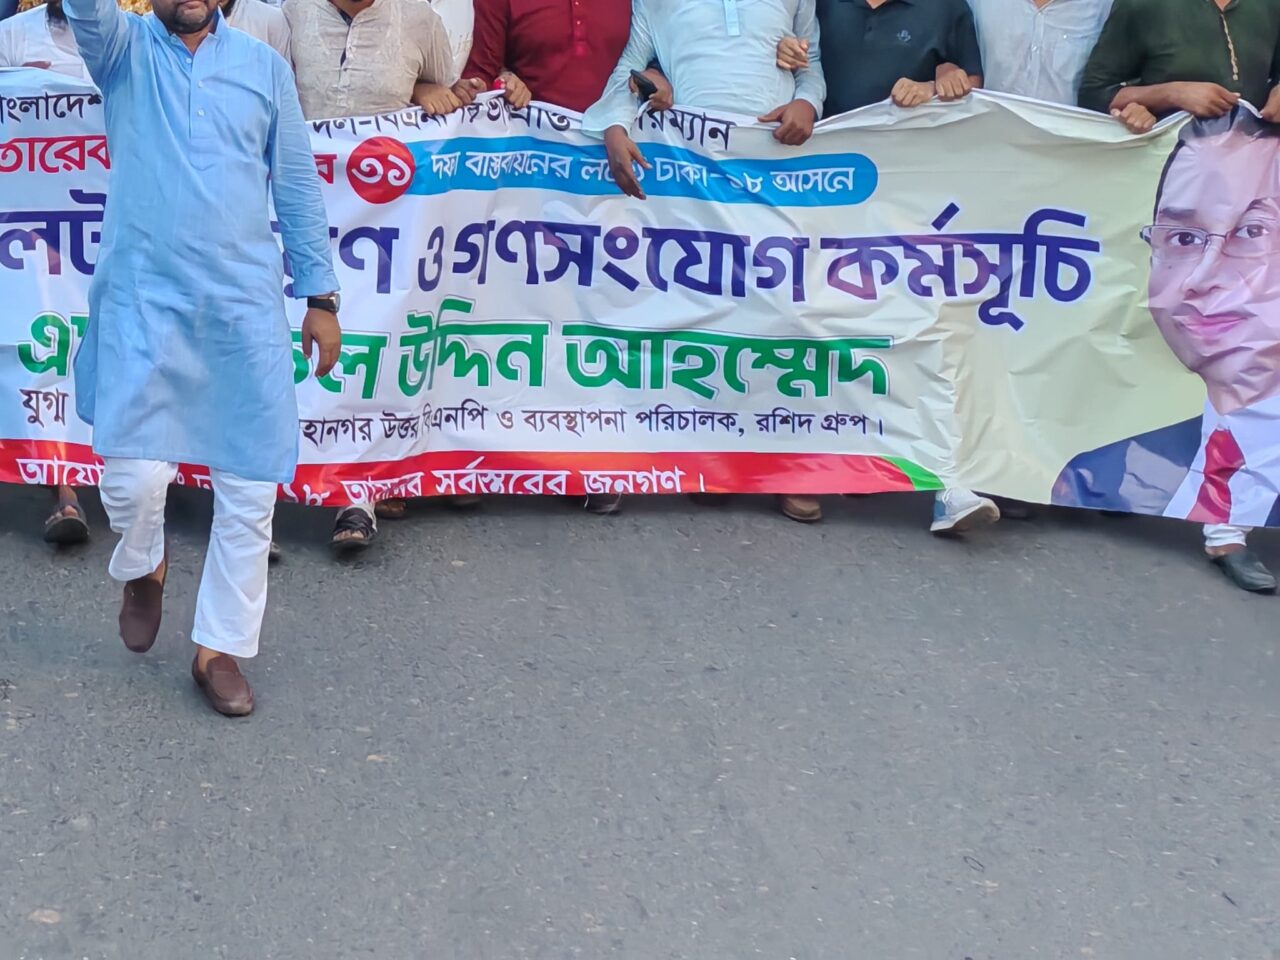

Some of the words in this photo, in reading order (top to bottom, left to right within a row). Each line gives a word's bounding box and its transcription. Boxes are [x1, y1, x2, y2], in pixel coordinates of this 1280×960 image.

[351, 154, 412, 187] ৩১
[431, 151, 461, 180] দফা
[465, 150, 573, 180] বাস্তবায়নের
[769, 167, 856, 193] আসনে
[418, 226, 444, 292] ও
[452, 219, 810, 303] গণসংযোগ
[820, 202, 1100, 332] কর্মসূচি
[399, 299, 549, 397] উদ্দিন
[562, 324, 891, 399] আহম্মেদ
[20, 389, 69, 427] যুগ্ম
[299, 414, 373, 446] হানগর
[380, 409, 421, 440] উত্তর
[422, 397, 489, 433] বিএনপি
[496, 410, 515, 430] ও
[522, 408, 626, 437] ব্যবস্থাপনা
[635, 404, 745, 437] পরিচালক,
[755, 406, 815, 434] রশিদ
